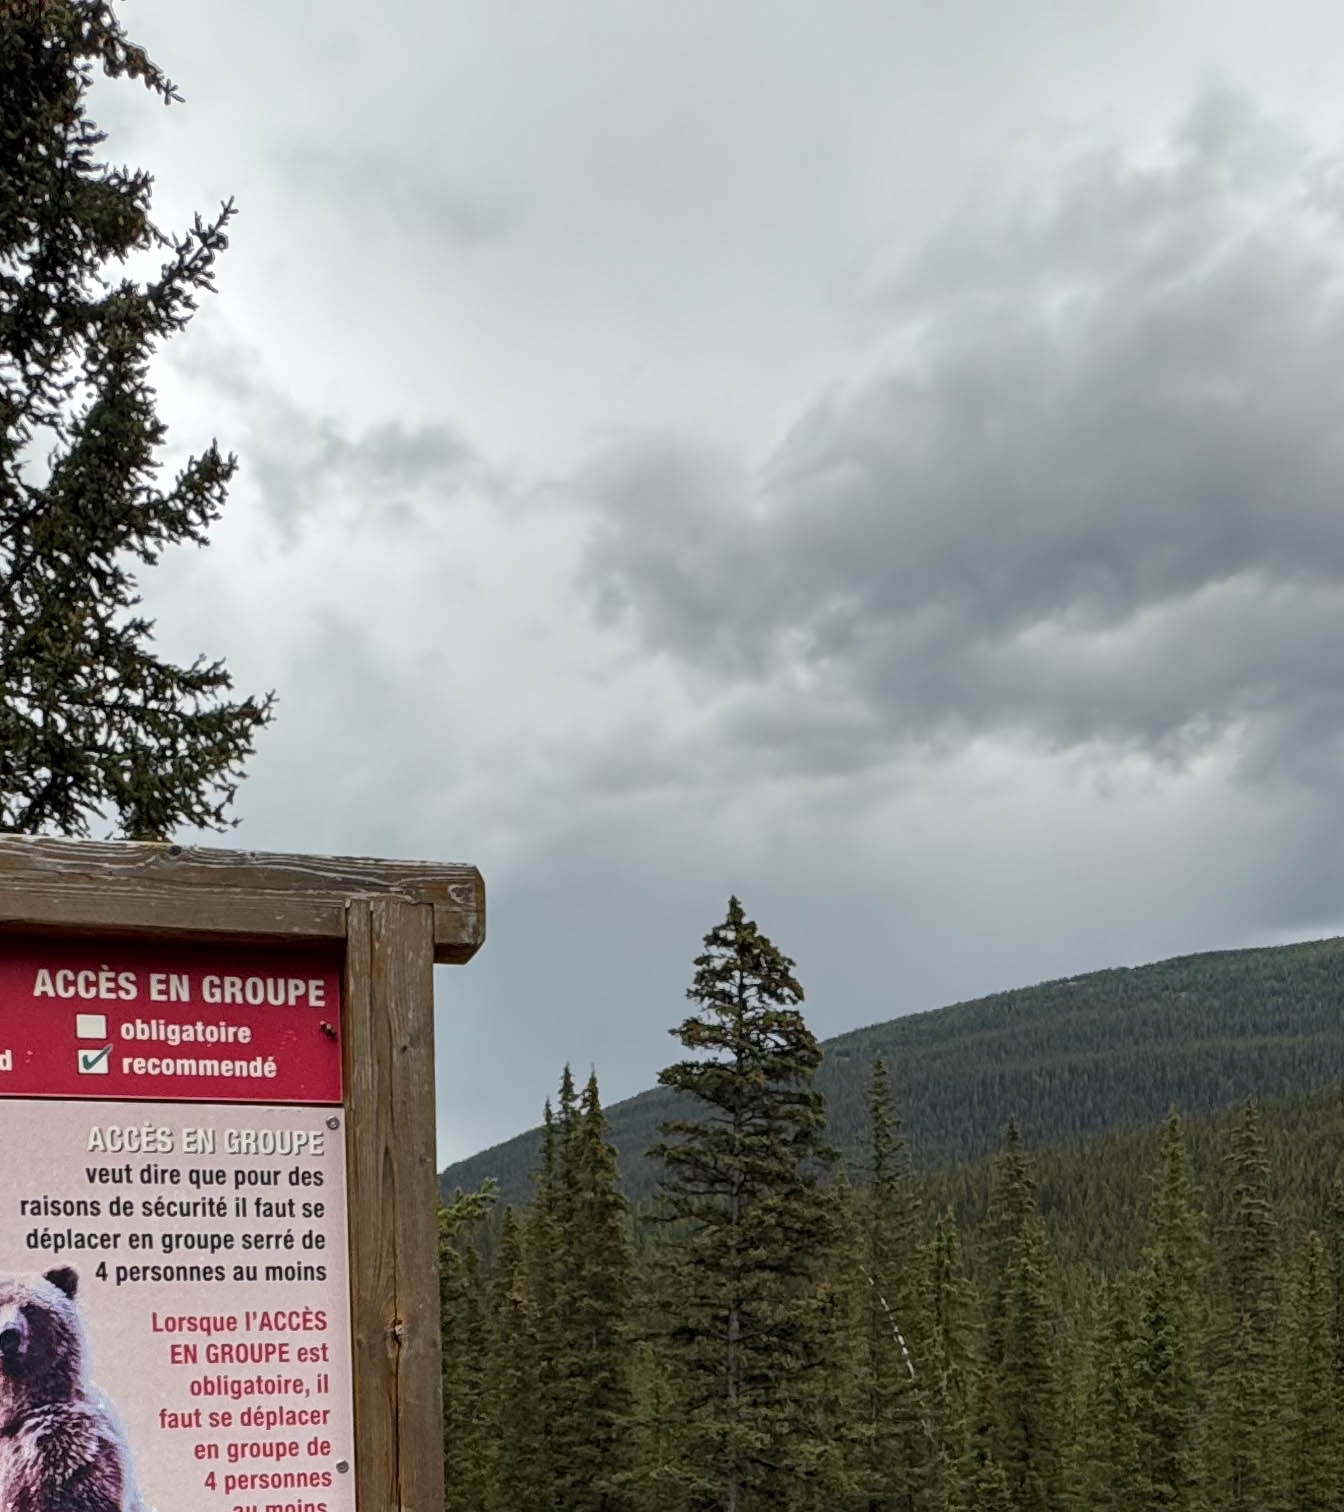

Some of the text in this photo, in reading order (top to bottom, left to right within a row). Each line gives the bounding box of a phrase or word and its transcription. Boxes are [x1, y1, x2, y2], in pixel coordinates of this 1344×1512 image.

[34, 965, 325, 1007] ACCÈS EN GROUPE
[121, 1019, 251, 1048] obligatoire
[122, 1056, 277, 1077] recommendé
[88, 1125, 324, 1156] ACCÈS EN GROUPE
[85, 1165, 324, 1191] veut dire que pour des
[20, 1196, 325, 1218] raisons de sécurité il faut se
[26, 1228, 326, 1255] déplacer en groupe serré de
[96, 1261, 326, 1286] 4 personnes au moins
[152, 1306, 327, 1336] Lorsque l'ACCÈS
[170, 1343, 329, 1364] EN GROUPE est
[190, 1374, 329, 1399] obligatoire, il
[159, 1405, 330, 1430] faut se déplacer
[194, 1437, 331, 1463] en groupe de
[205, 1471, 332, 1494] 4 personnes
